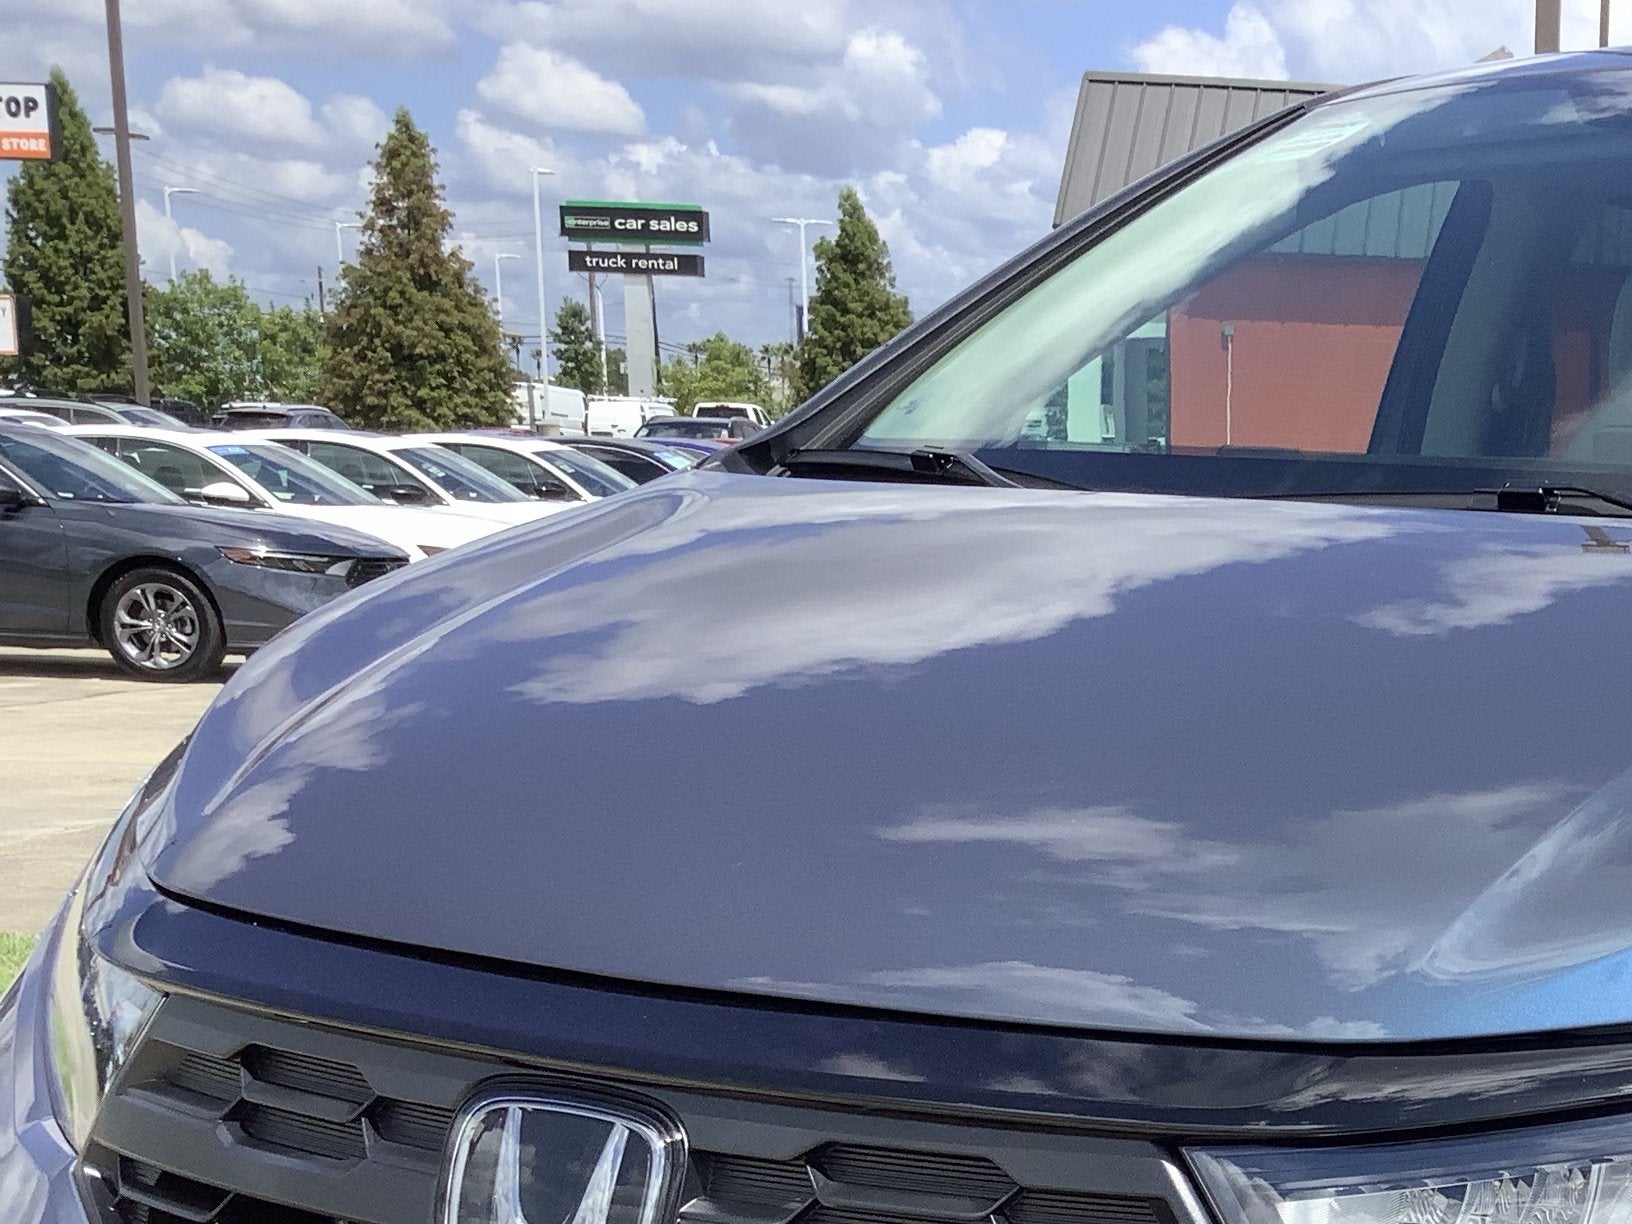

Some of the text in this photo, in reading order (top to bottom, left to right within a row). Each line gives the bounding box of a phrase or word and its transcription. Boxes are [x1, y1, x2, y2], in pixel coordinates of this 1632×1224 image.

[0, 95, 39, 119] OP
[1, 137, 47, 152] STORE
[614, 218, 646, 230] car
[649, 216, 700, 233] sales
[584, 254, 679, 271] truck rental
